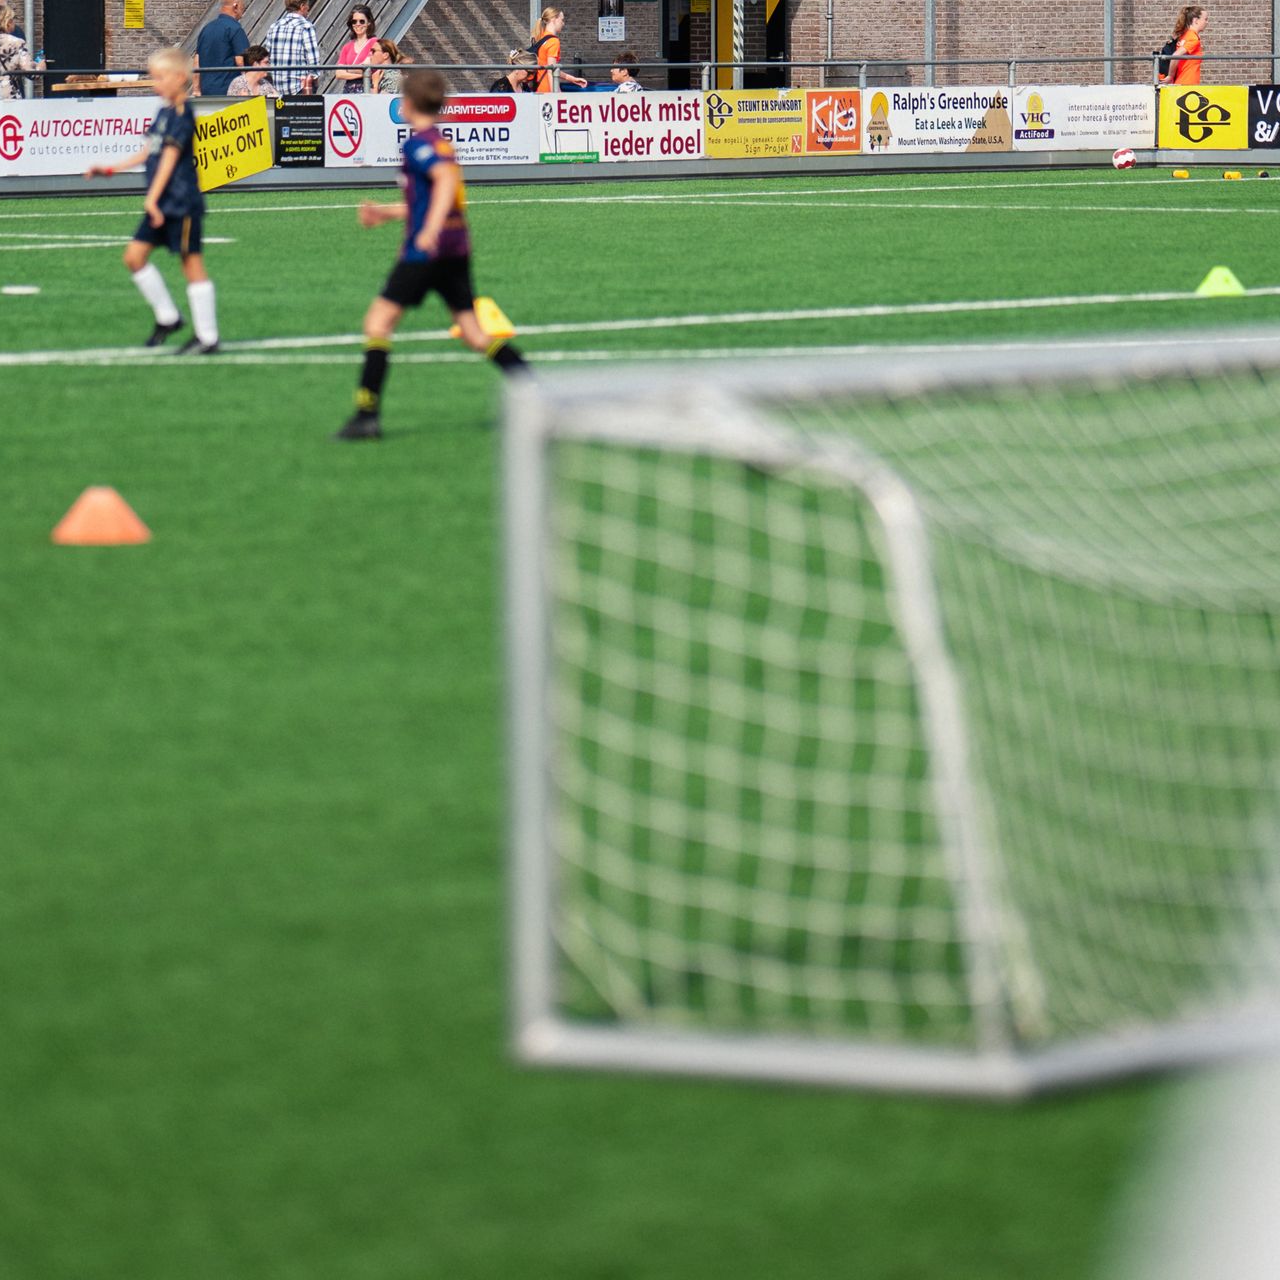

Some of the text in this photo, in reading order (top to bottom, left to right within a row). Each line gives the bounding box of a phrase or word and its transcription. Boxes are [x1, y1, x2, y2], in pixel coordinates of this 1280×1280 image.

[737, 99, 802, 112] STEUNT EN SPONSORT
[893, 91, 1008, 115] Ralph's Greenhouse
[1068, 102, 1148, 113] internationale groothandel
[438, 105, 510, 115] WARMTEPOMP
[557, 96, 701, 124] Een vloek mist
[915, 116, 987, 130] Eat a Leek a Week
[1020, 112, 1051, 125] VHC
[1082, 114, 1102, 122] horeca
[1108, 113, 1149, 123] grootverbruik
[29, 118, 152, 137] AUTOCENTRALE
[195, 112, 251, 142] Welkom
[397, 127, 510, 143] FSLAND
[724, 136, 749, 145] mogelijk
[752, 136, 773, 144] gemaakt
[1020, 129, 1049, 139] ActiFood
[211, 143, 233, 161] v.v.
[236, 128, 264, 152] ONT
[604, 128, 701, 156] ieder doel
[898, 137, 916, 146] Mount
[939, 136, 971, 147] Washington
[476, 146, 509, 154] verwarming
[745, 144, 761, 155] Sign
